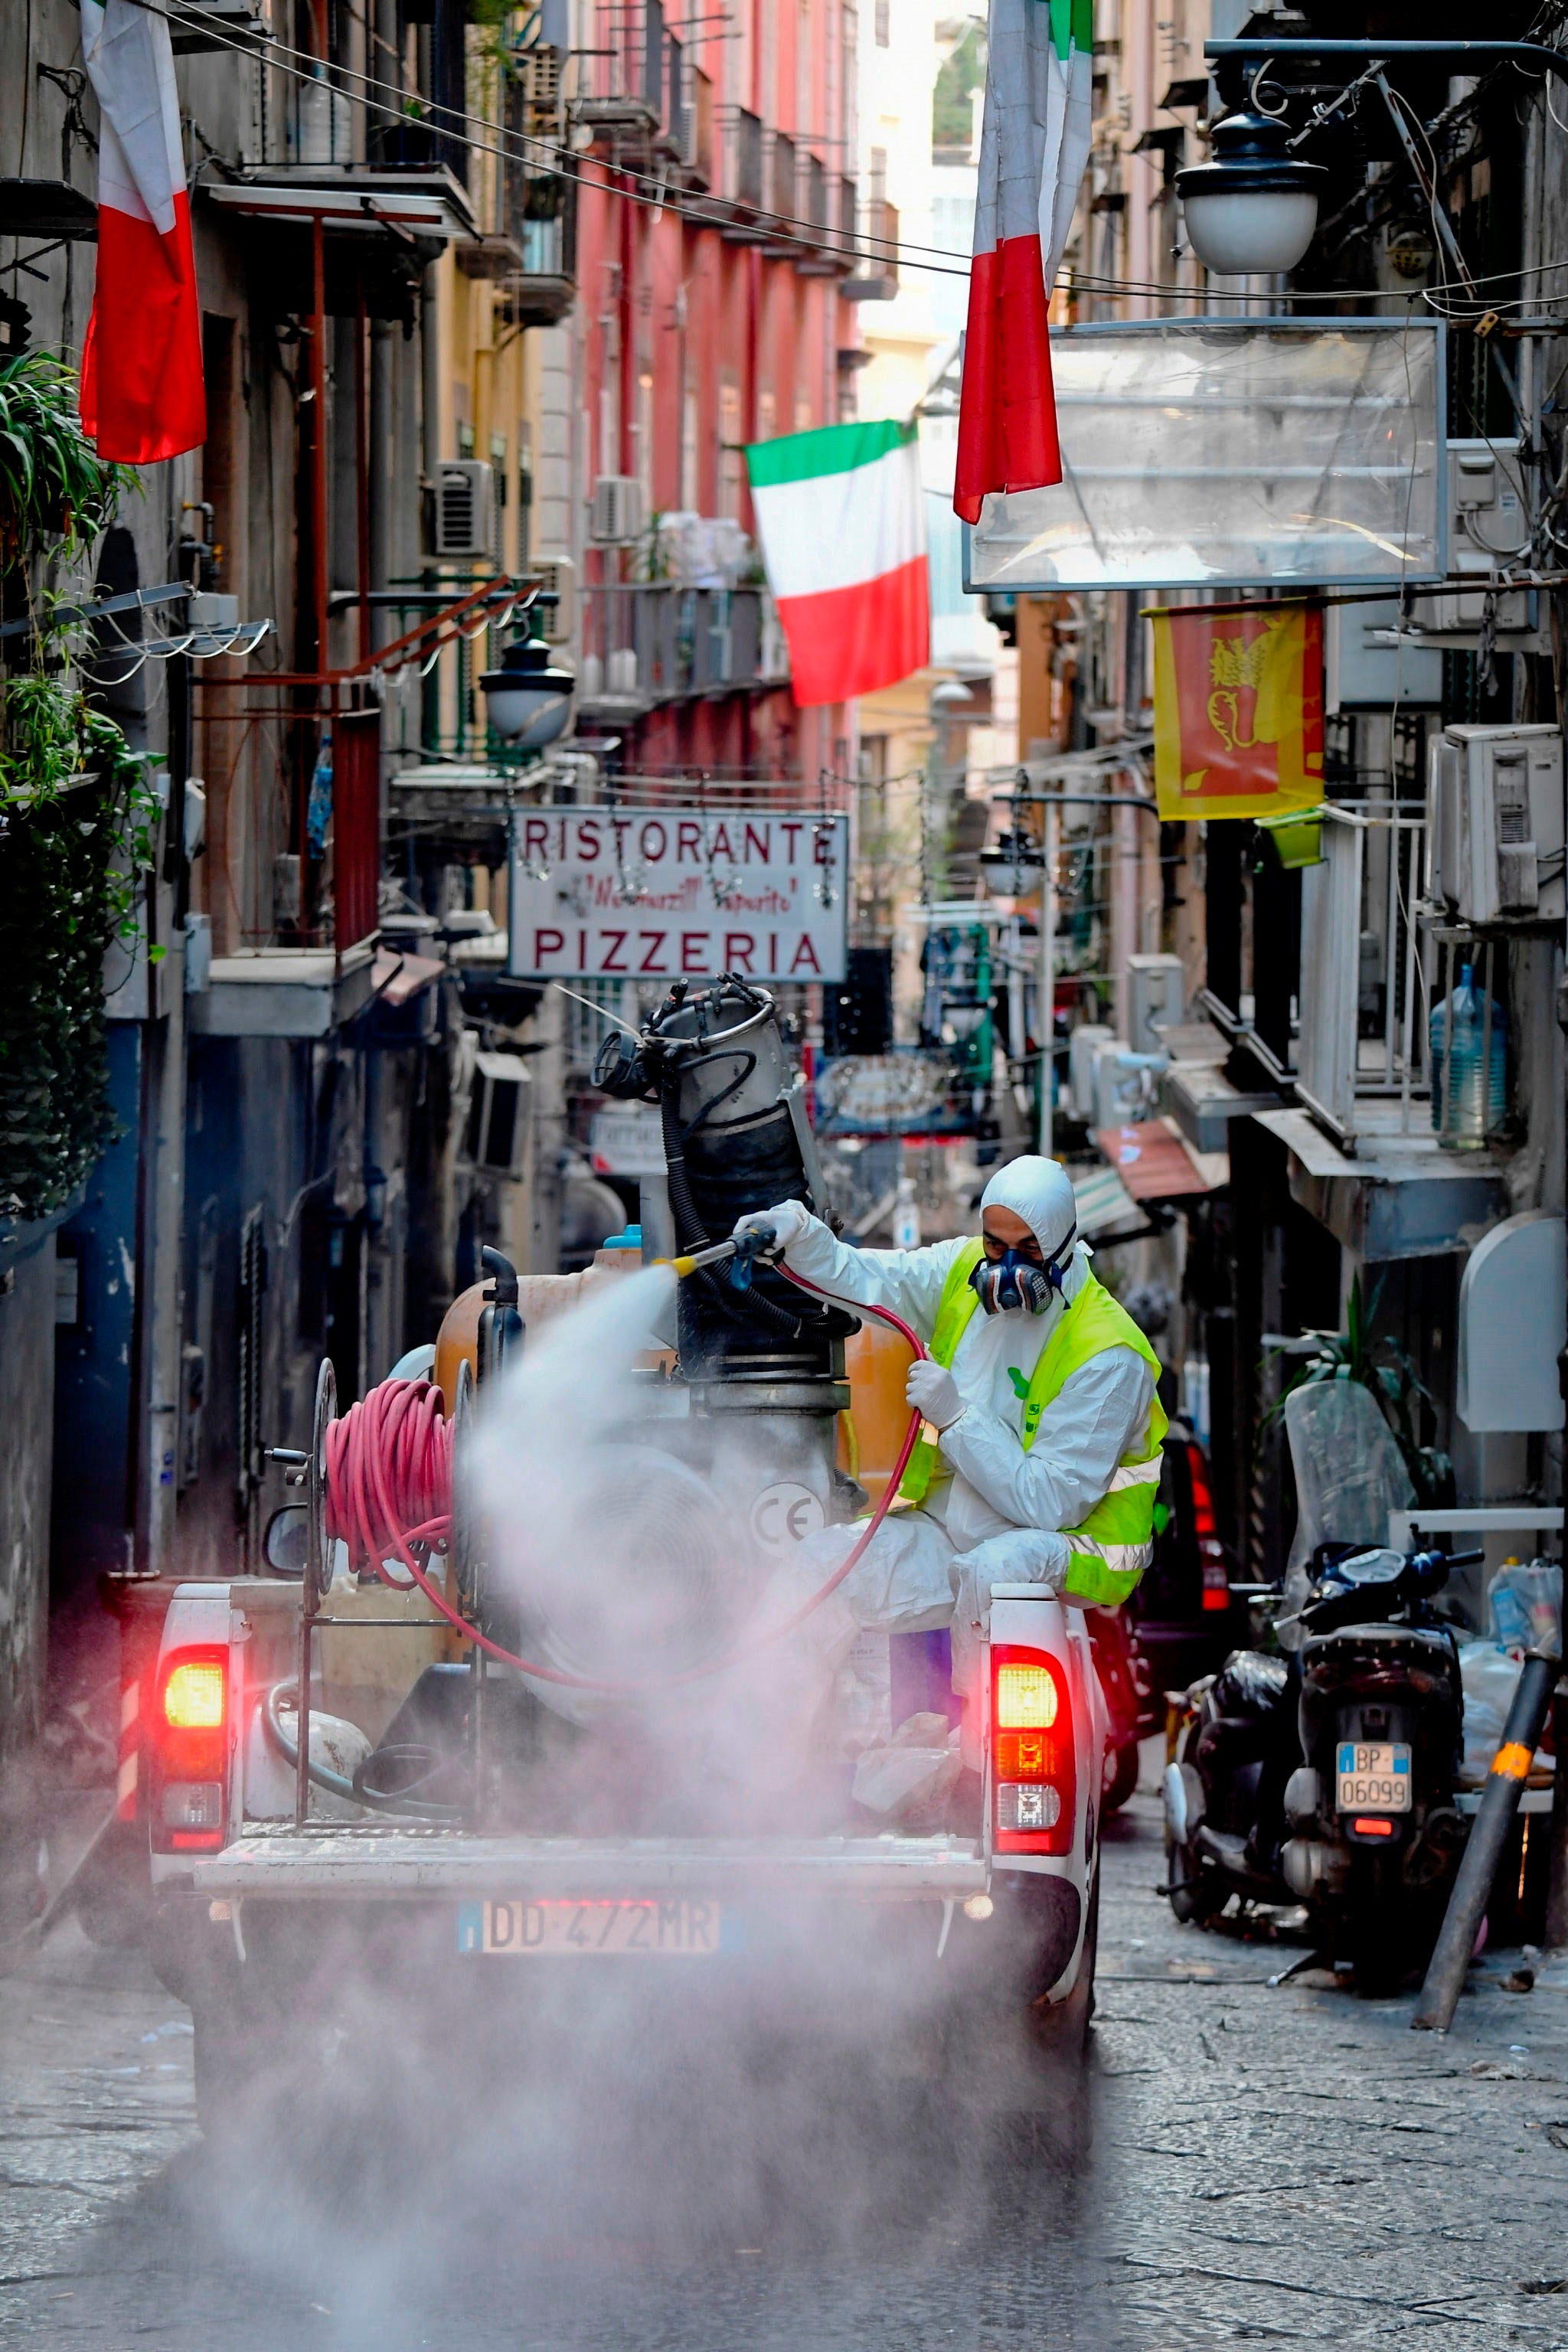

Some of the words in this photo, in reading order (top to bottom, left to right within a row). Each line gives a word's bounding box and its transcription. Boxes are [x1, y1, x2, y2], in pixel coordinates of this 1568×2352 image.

[524, 818, 836, 865] RISTORANTE
[534, 929, 822, 974] PIZZERIA
[1357, 1748, 1380, 1771] BP
[1343, 1779, 1405, 1805] 06099
[490, 1901, 545, 1948] DD
